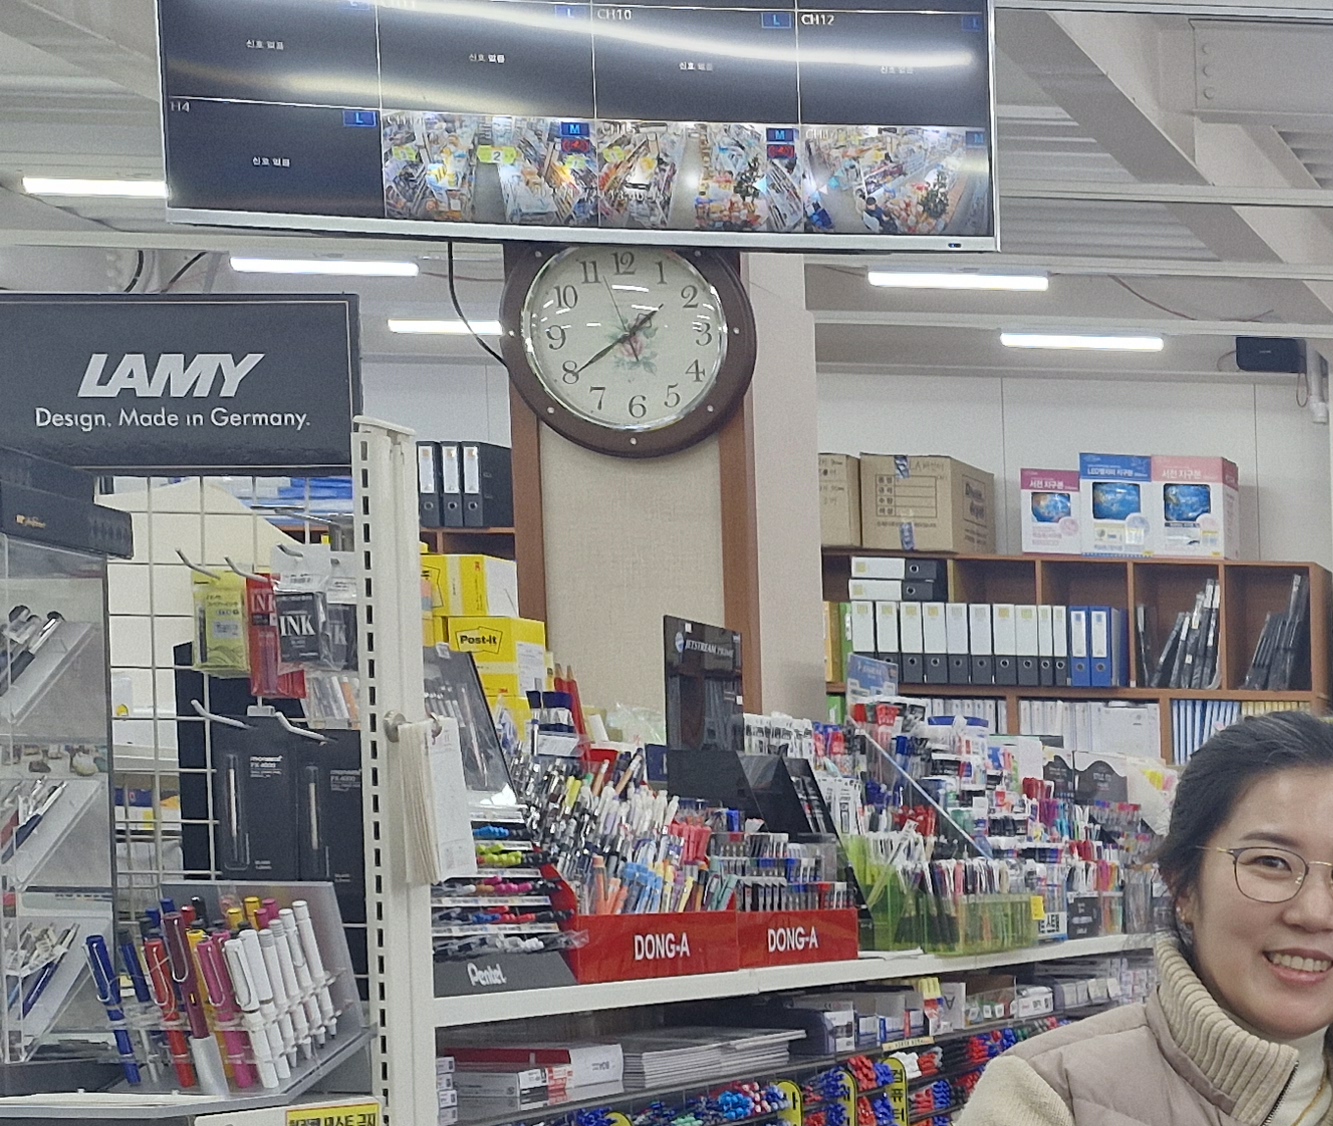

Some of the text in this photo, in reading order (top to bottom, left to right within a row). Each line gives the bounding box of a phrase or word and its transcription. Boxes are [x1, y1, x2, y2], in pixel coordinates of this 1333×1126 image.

[801, 13, 835, 27] CH12
[580, 260, 601, 284] 11
[614, 251, 636, 276] 12
[655, 261, 668, 285] 1
[554, 284, 578, 309] 10
[681, 285, 699, 309] 2
[546, 325, 567, 350] 9
[696, 322, 712, 347] 3
[77, 353, 266, 398] LAMY
[562, 360, 580, 385] 8
[685, 359, 706, 382] 4
[589, 386, 606, 411] 7
[628, 395, 647, 418] 6
[664, 383, 681, 408] 5
[119, 407, 179, 428] Made
[187, 411, 205, 427] in
[210, 407, 312, 431] Germany.
[1044, 481, 1065, 489] 지구본
[279, 614, 316, 637] INK
[460, 633, 498, 648] Post-it
[633, 931, 691, 962] DONG-A
[768, 925, 819, 953] DONG-A
[467, 962, 508, 988] Pentel
